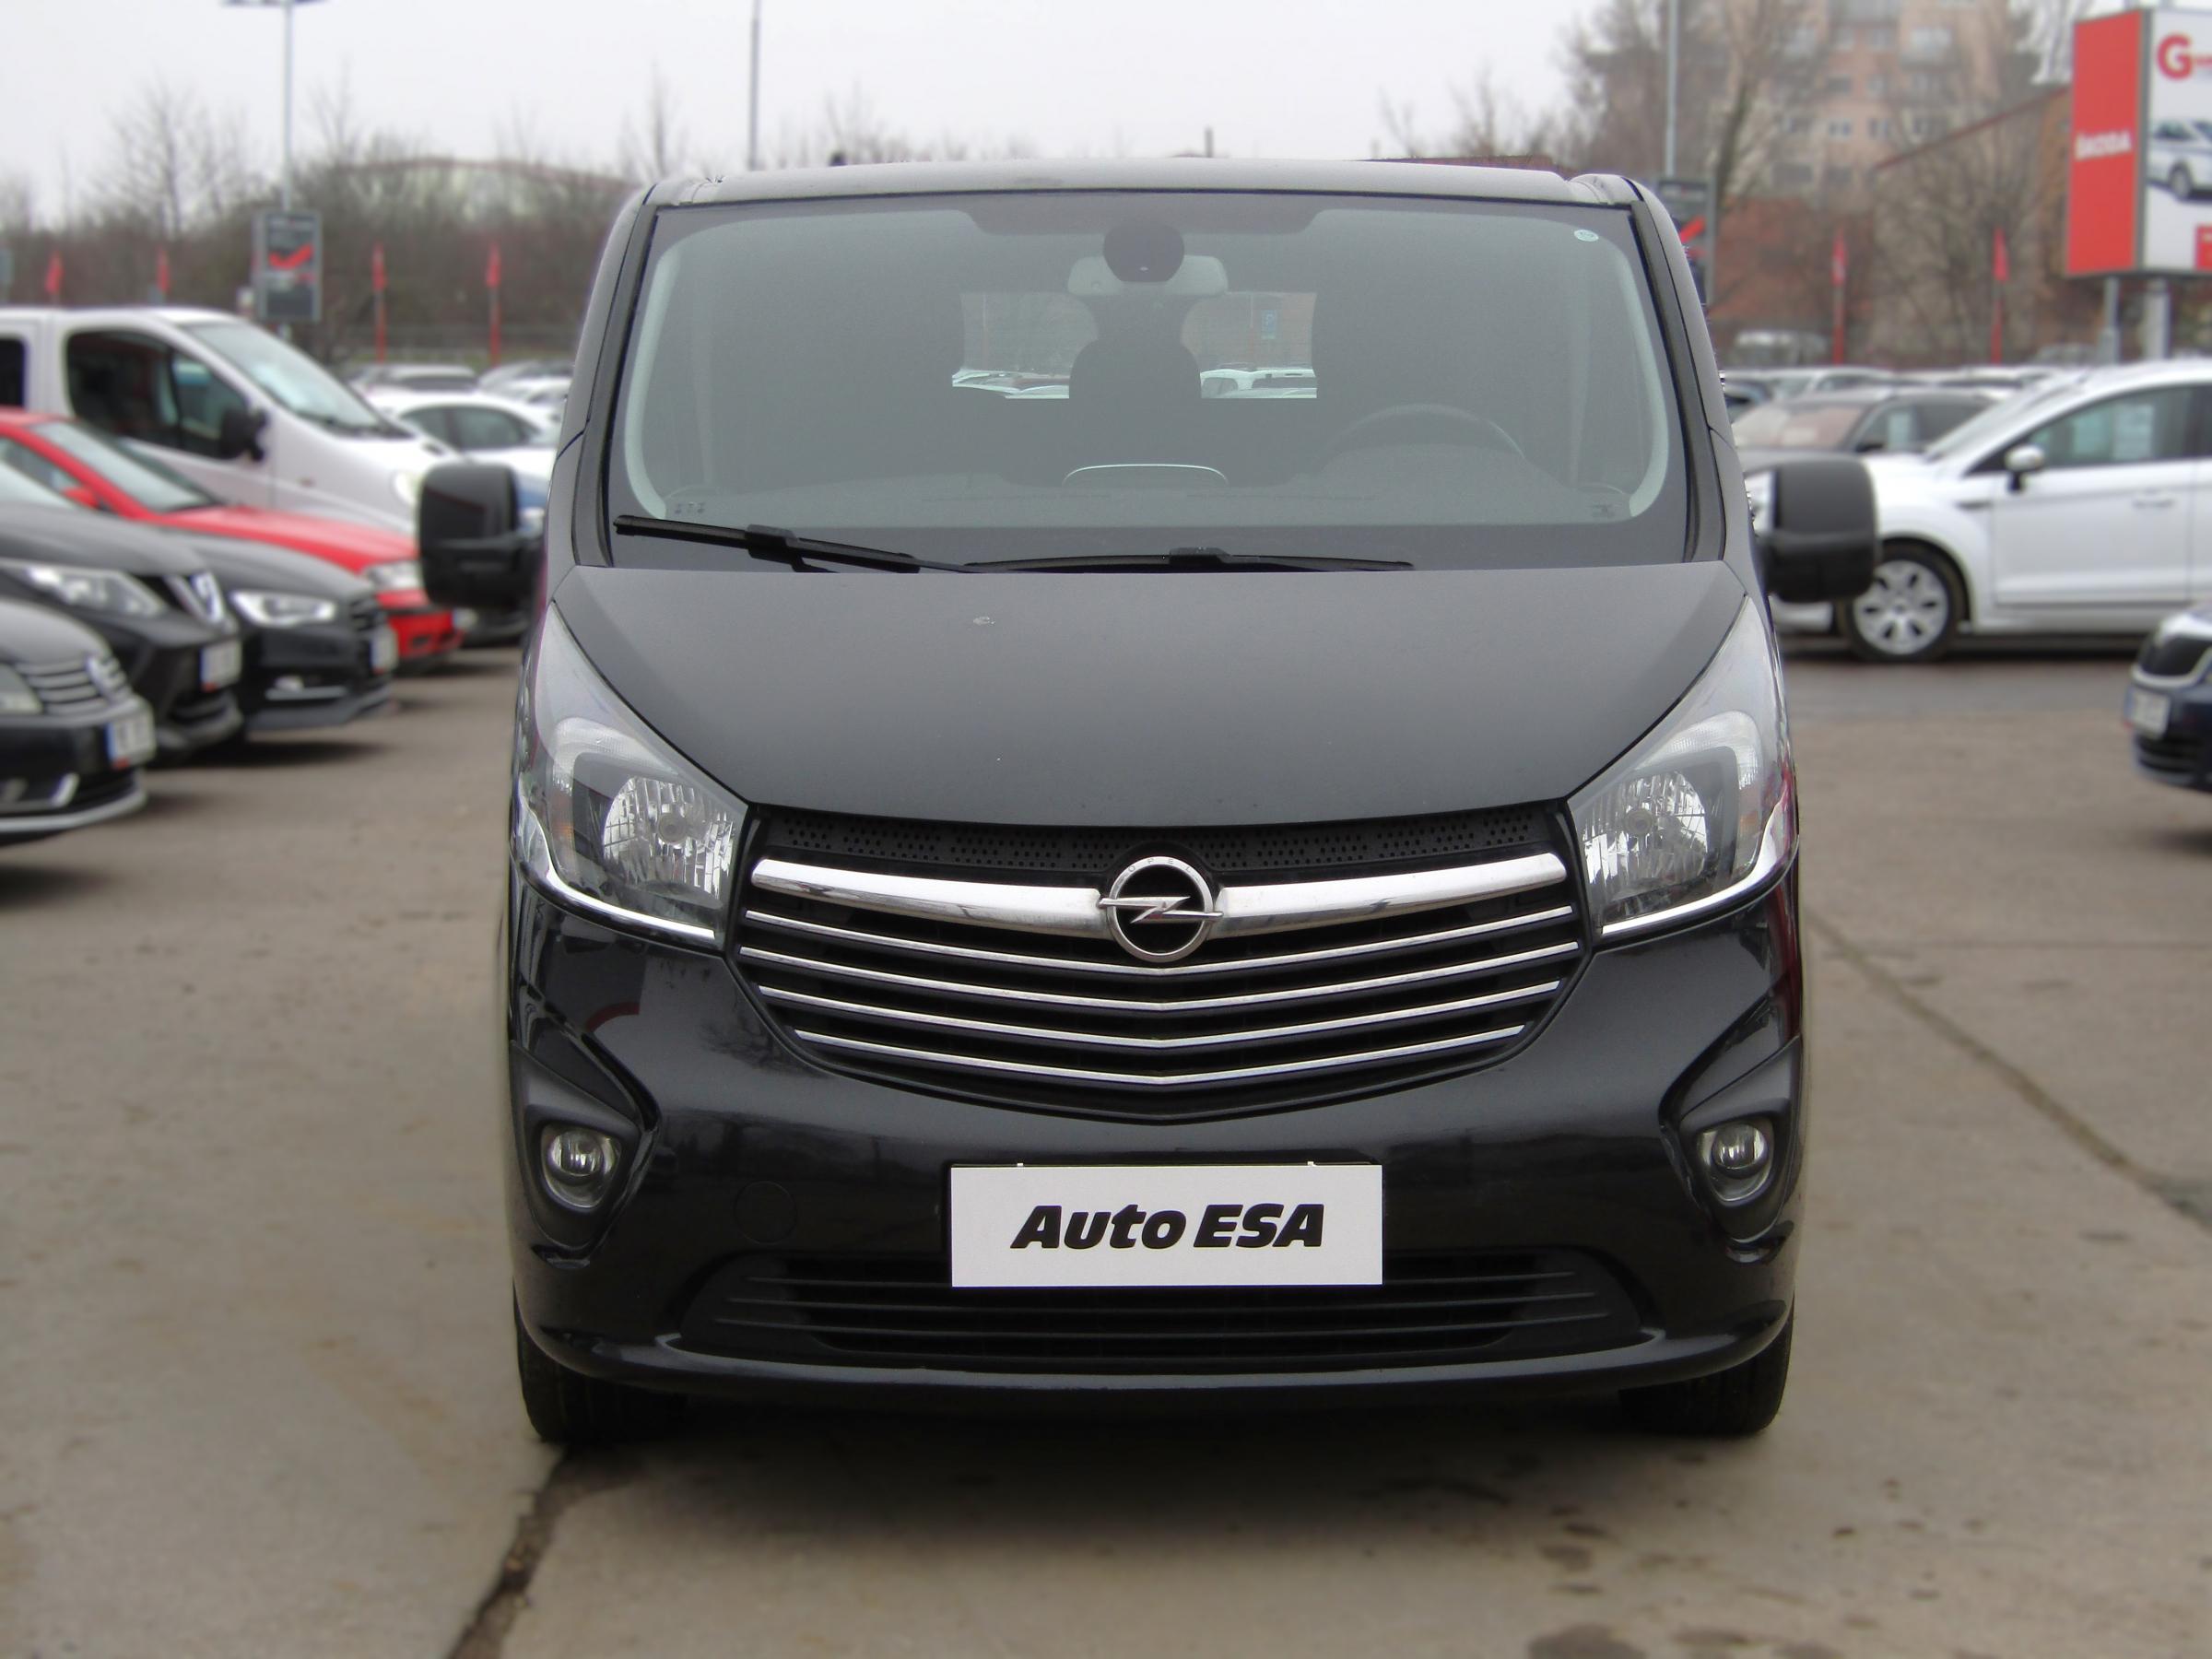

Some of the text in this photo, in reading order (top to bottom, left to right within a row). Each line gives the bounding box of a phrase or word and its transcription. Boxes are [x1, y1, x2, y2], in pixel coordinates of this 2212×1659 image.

[1128, 858, 1192, 873] OPEL
[1010, 1203, 1324, 1250] Auto ESA
